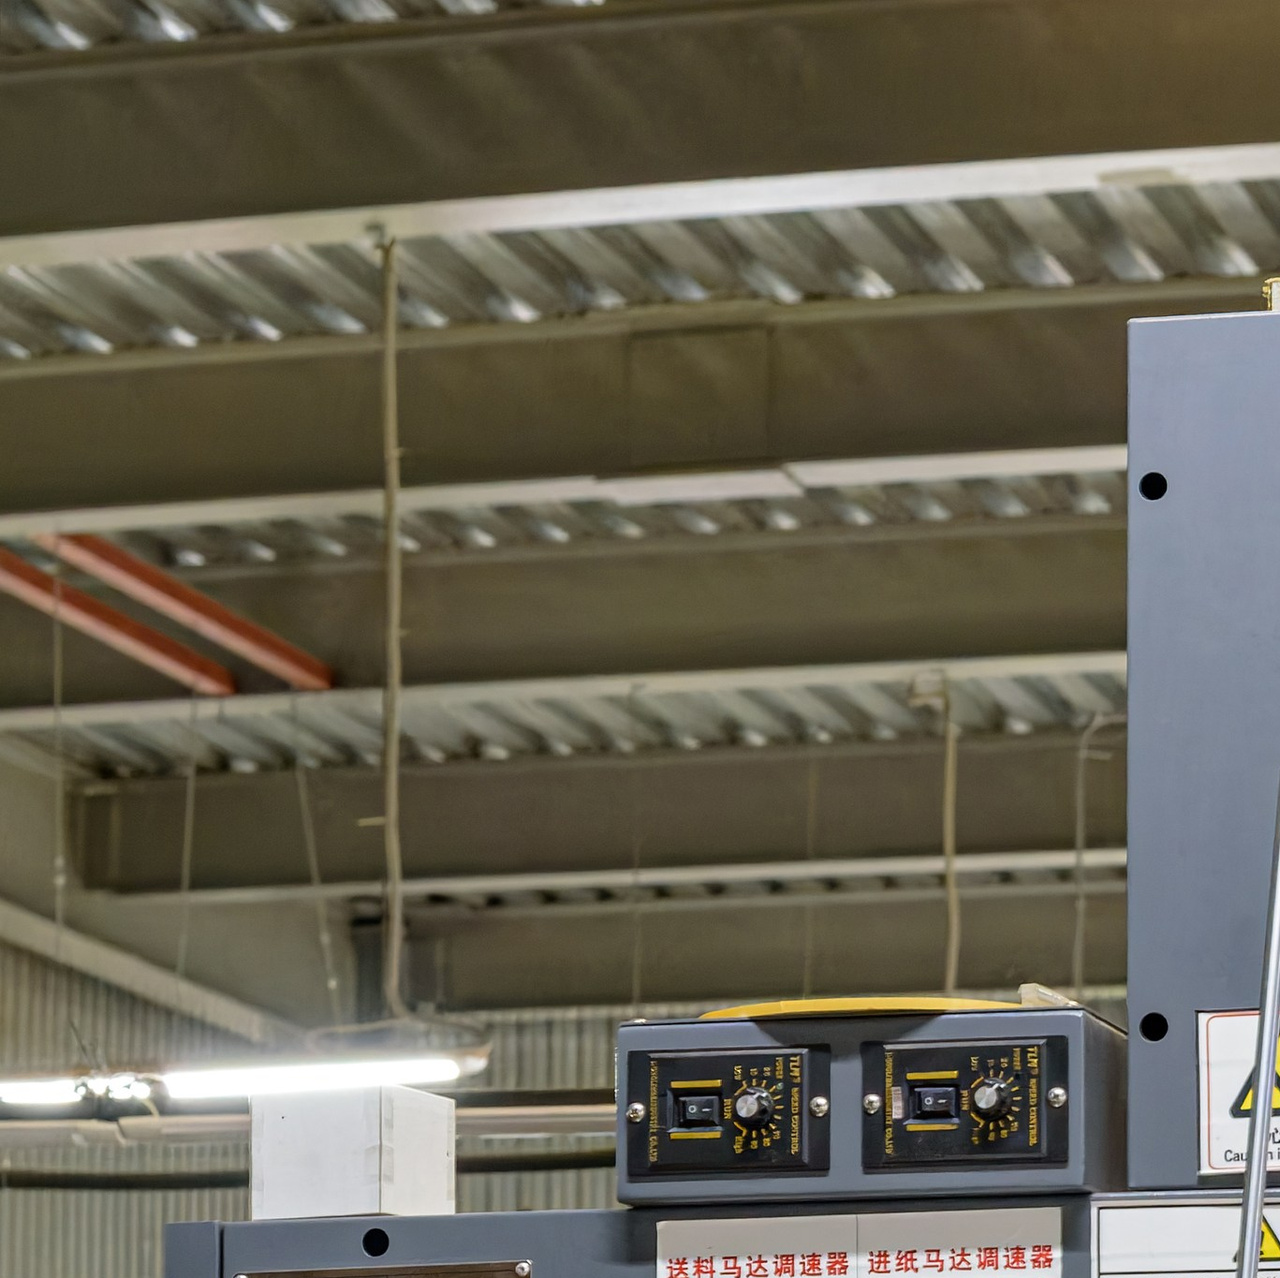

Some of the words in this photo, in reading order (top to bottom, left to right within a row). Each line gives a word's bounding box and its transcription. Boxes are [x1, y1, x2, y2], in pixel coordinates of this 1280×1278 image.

[723, 1098, 732, 1120] RUN
[960, 1089, 969, 1111] RUN
[790, 1115, 800, 1155] CONTROL
[1029, 1107, 1038, 1147] CONTROL
[1224, 1149, 1273, 1162] Caun
[866, 1244, 1054, 1276] 进纸马达调速器
